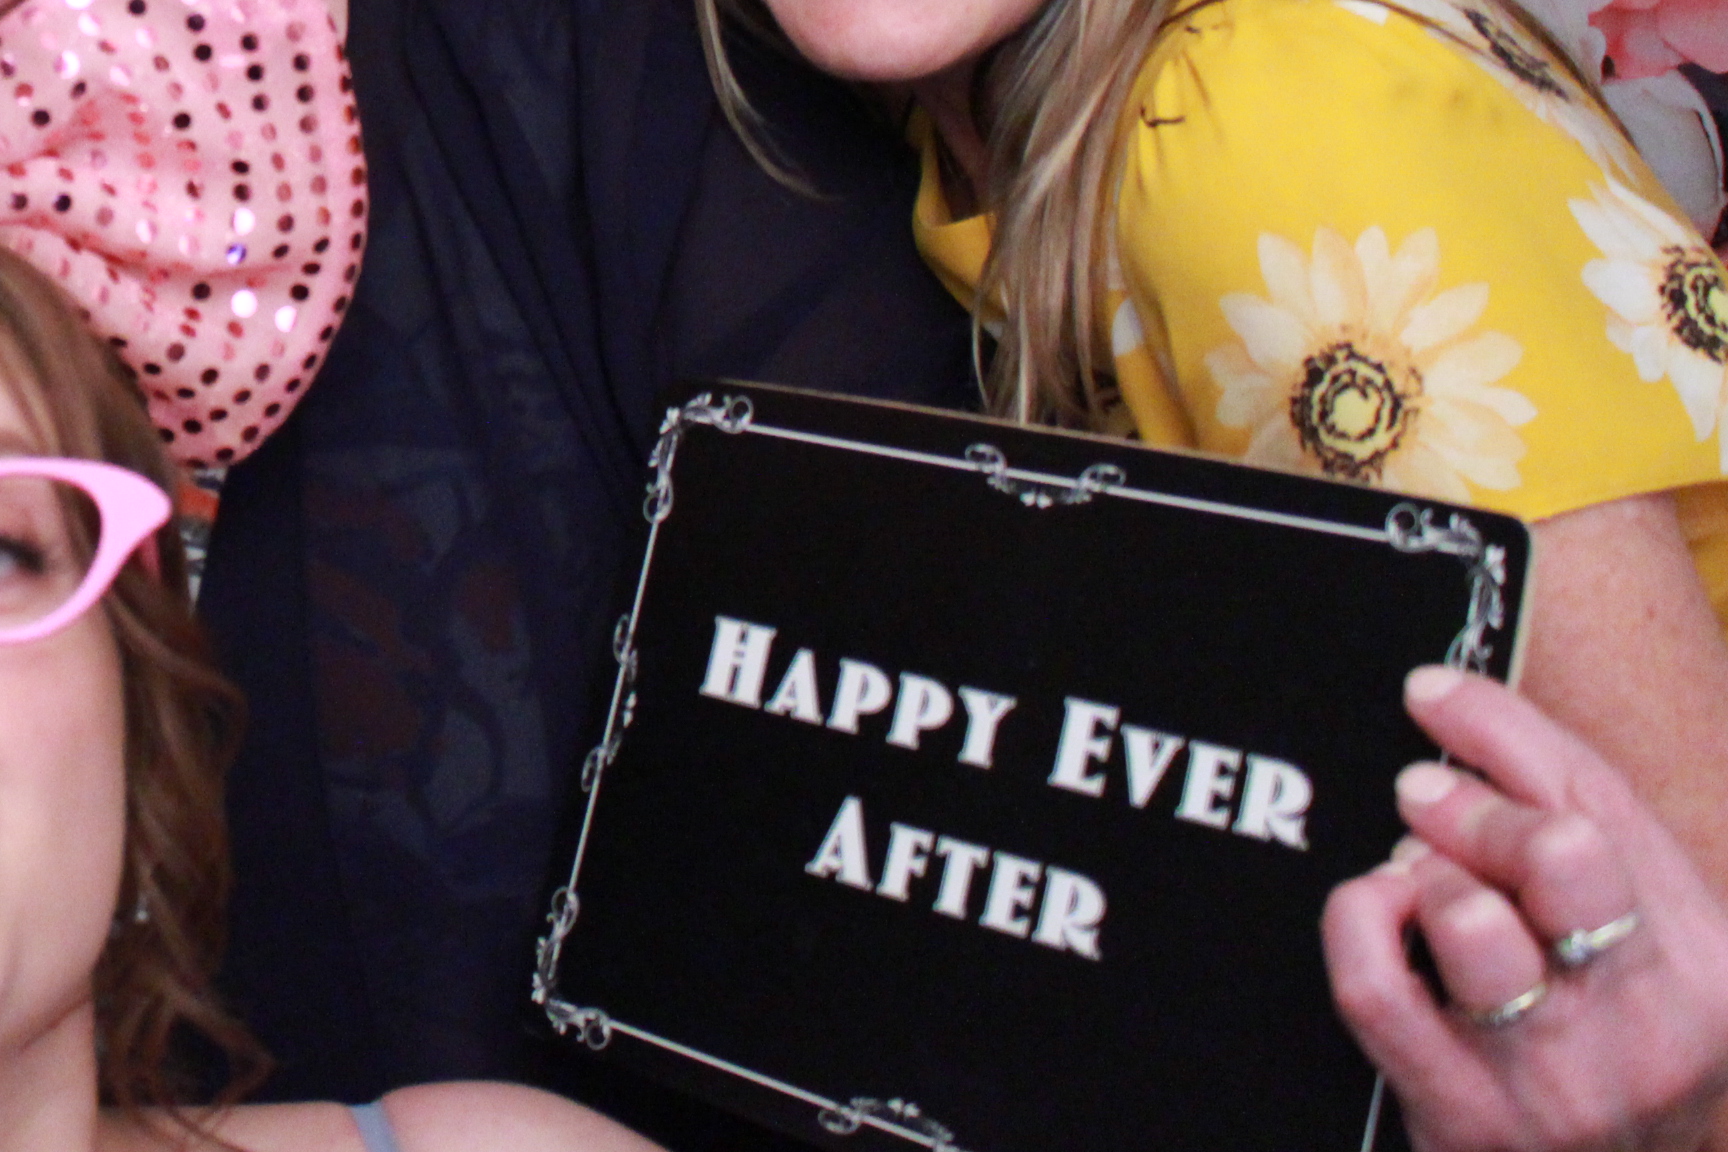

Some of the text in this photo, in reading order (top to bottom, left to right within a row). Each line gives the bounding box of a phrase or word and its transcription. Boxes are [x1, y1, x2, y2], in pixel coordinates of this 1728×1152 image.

[699, 615, 1314, 851] HAPPY EVER
[804, 794, 1108, 962] AFTER
